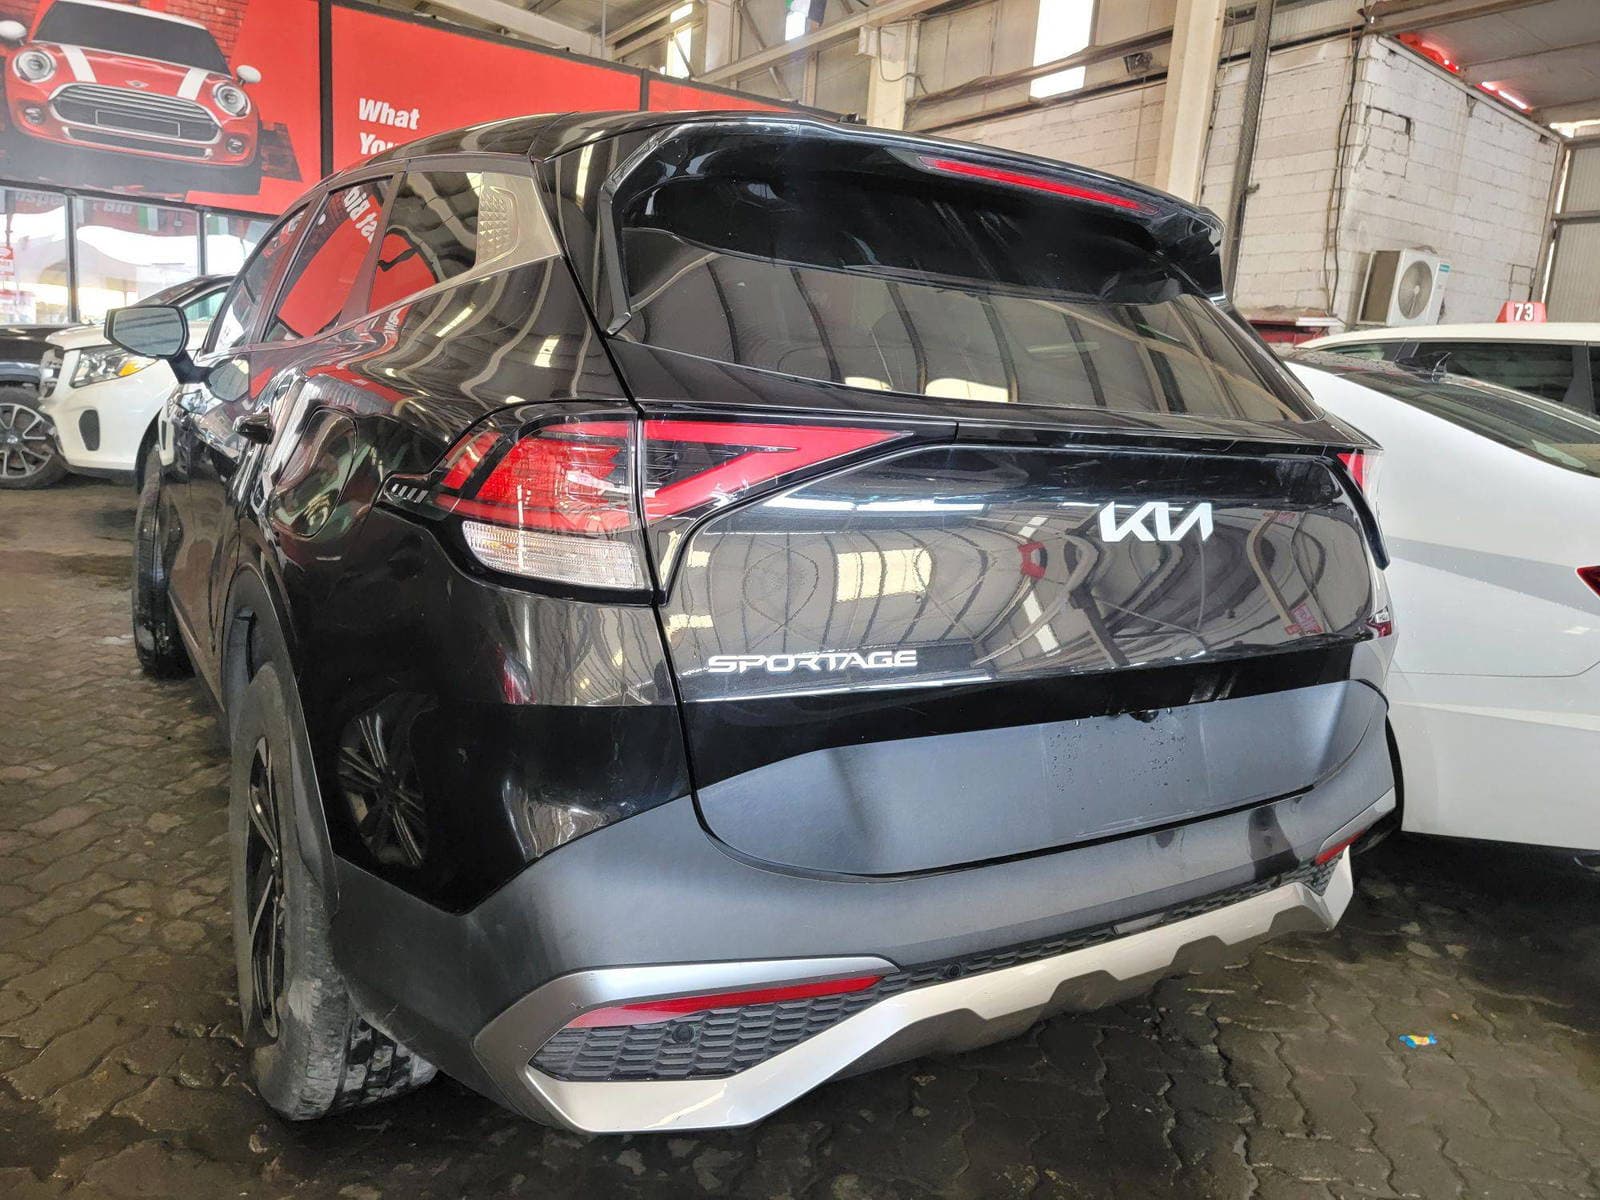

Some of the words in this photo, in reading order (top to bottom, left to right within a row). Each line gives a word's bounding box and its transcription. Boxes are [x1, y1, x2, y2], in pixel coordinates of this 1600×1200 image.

[359, 97, 420, 130] What
[360, 132, 400, 155] Yo
[1514, 303, 1534, 321] 73
[1100, 501, 1213, 542] KIA
[707, 650, 918, 673] SPORTAGE
